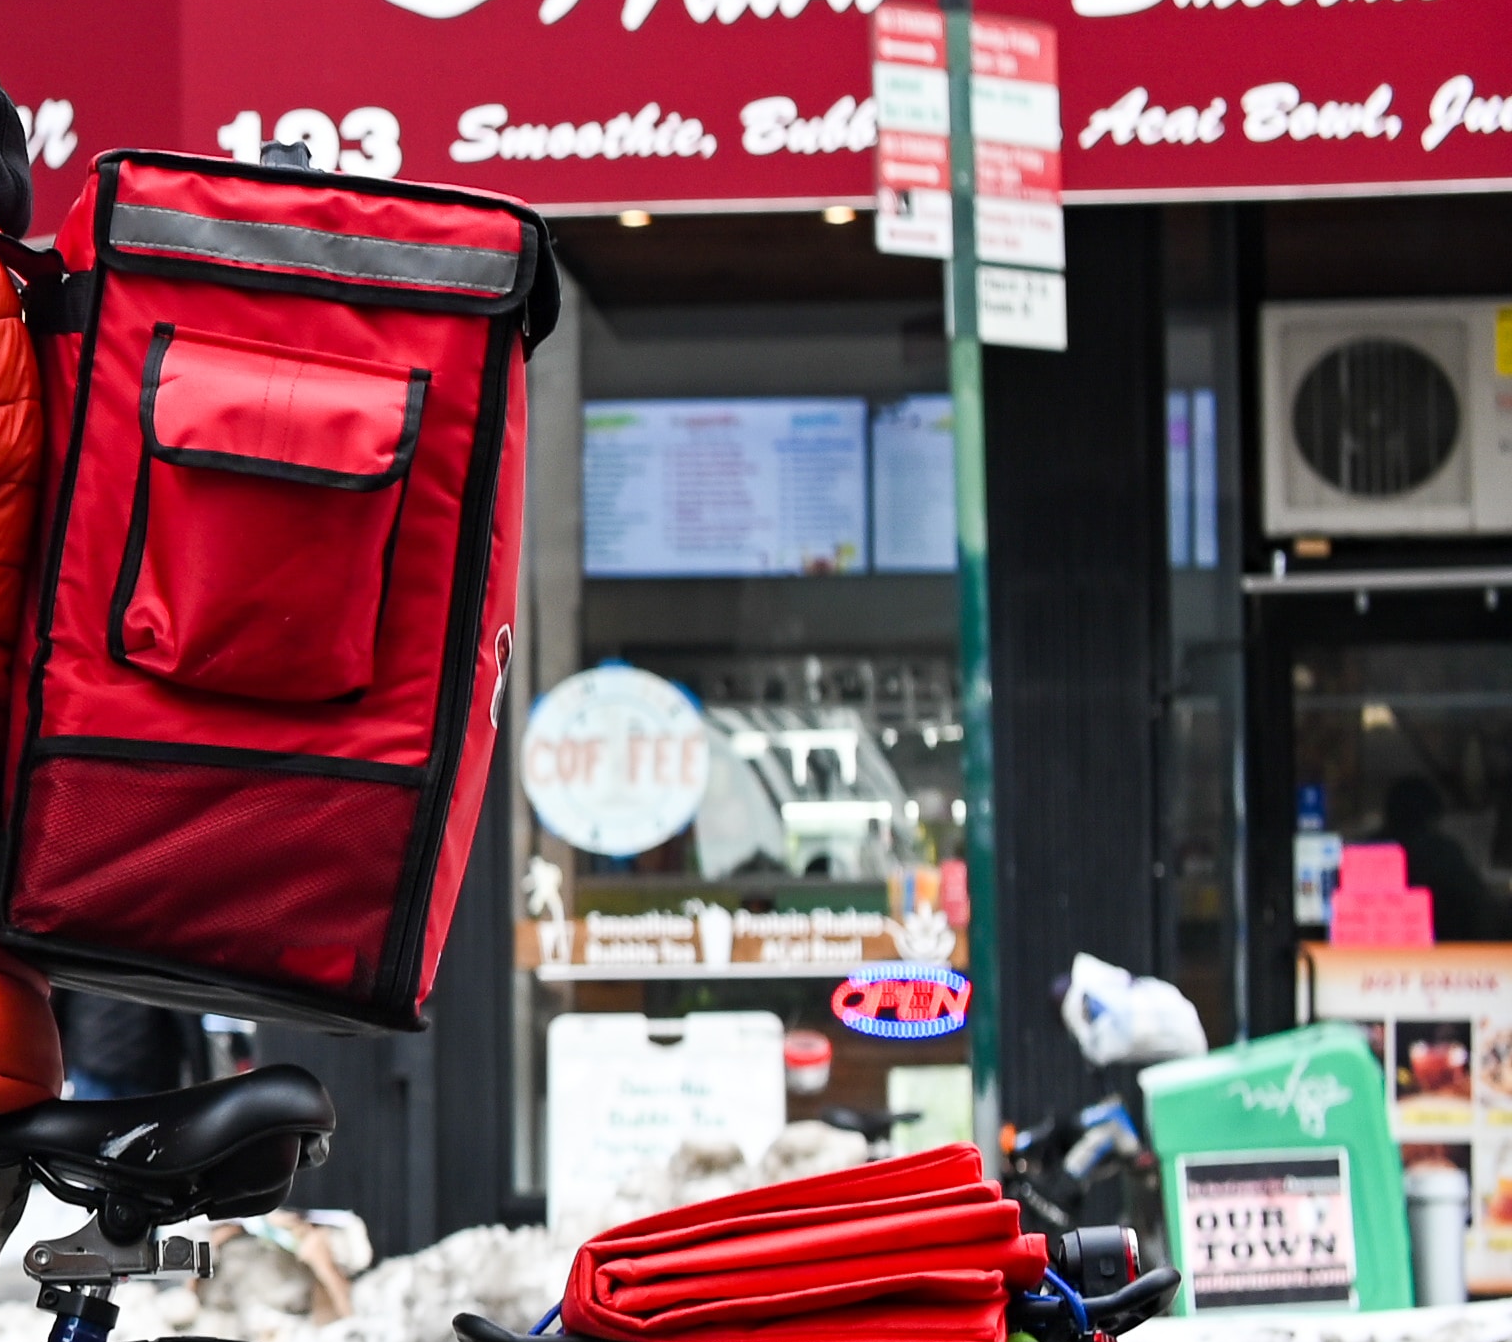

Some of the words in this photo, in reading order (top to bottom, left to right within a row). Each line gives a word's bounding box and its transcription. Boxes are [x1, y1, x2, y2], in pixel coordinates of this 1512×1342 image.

[217, 106, 403, 180] 193
[450, 102, 717, 162] Smoothie,
[1241, 82, 1403, 142] Bowl,
[831, 978, 974, 1023] OPEN
[1195, 1208, 1285, 1231] OUR
[1197, 1234, 1337, 1261] TOWN
